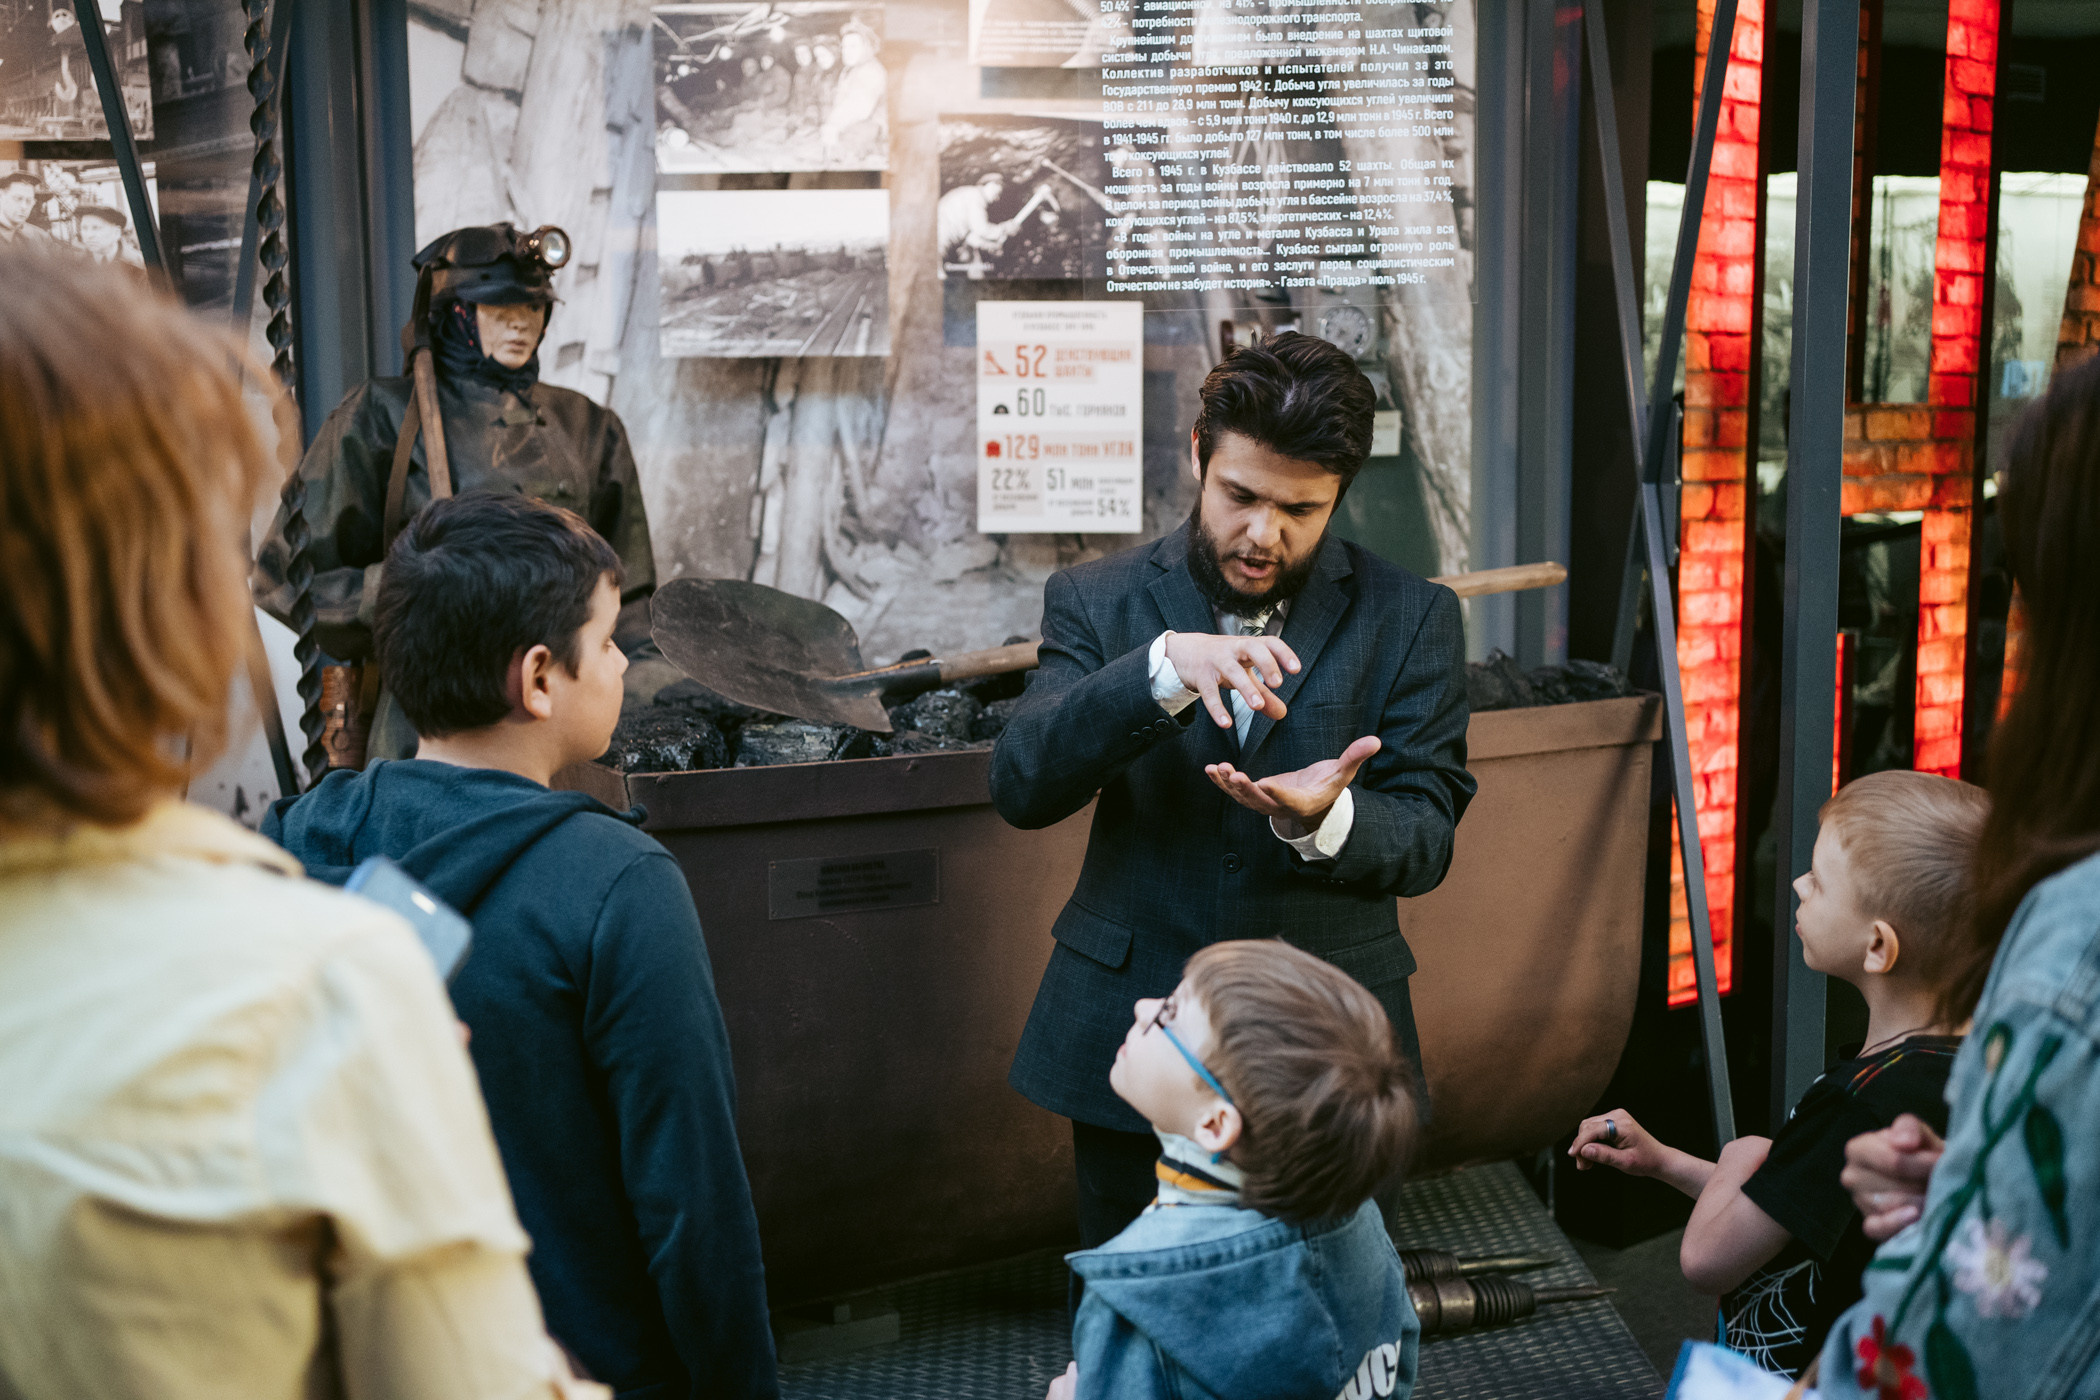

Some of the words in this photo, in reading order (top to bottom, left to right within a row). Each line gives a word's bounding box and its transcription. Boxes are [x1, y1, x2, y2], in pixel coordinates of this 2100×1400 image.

[1132, 15, 1196, 29] потребности
[1302, 13, 1363, 25] транспорта.
[1110, 32, 1175, 47] Крупнейшим
[1255, 30, 1282, 42] было
[1288, 31, 1343, 42] внедрение
[1348, 30, 1360, 39] на
[1366, 29, 1403, 39] шахтах
[1408, 25, 1453, 39] щитовой
[1102, 52, 1147, 63] системы
[1151, 49, 1191, 63] добычи
[1306, 47, 1365, 58] инженером
[1370, 43, 1389, 55] Н.А.
[1393, 43, 1453, 55] Чинакалом.
[1102, 67, 1163, 79] Коллектив
[1170, 65, 1258, 79] разработчиков
[1265, 66, 1271, 75] и
[1278, 60, 1354, 74] испытателей
[1361, 62, 1408, 74] получил
[1415, 61, 1428, 70] за
[1435, 61, 1453, 70] это
[1102, 84, 1192, 97] Государственную
[1196, 83, 1236, 95] премию
[1240, 80, 1261, 92] 1942
[1274, 79, 1315, 93] Добыча
[1318, 81, 1340, 92] угля
[1343, 79, 1409, 92] увеличилась
[1412, 78, 1424, 88] за
[1428, 78, 1453, 88] годы
[1103, 100, 1123, 112] ВОВ
[1156, 101, 1169, 112] до
[1172, 98, 1193, 111] 28,9
[1197, 100, 1216, 109] млн
[1220, 99, 1245, 109] тонн.
[1249, 96, 1289, 110] Добычу
[1293, 96, 1363, 109] коксующихся
[1366, 93, 1395, 107] углей
[1398, 94, 1453, 106] увеличили
[1206, 114, 1220, 127] 5,9
[1222, 116, 1242, 125] млн
[1244, 115, 1267, 125] тонн
[1269, 112, 1291, 124] 1940
[1302, 114, 1315, 125] до
[1317, 111, 1334, 124] 12,9
[1337, 113, 1356, 122] млн
[1359, 112, 1381, 122] тонн
[1392, 109, 1413, 121] 1945
[1424, 109, 1453, 120] Всего
[1112, 132, 1158, 145] 1941-1945
[1175, 132, 1202, 143] было
[1205, 131, 1243, 144] добыто
[1246, 130, 1260, 141] 127
[1264, 131, 1283, 141] млн
[1287, 131, 1312, 141] тонн,
[1324, 130, 1342, 139] том
[1345, 129, 1375, 139] числе
[1379, 126, 1409, 138] более
[1412, 125, 1430, 137] 500
[1434, 127, 1453, 136] млн
[1129, 150, 1198, 162] коксующихся
[1200, 146, 1231, 161] углей.
[1113, 166, 1142, 178] Всего
[1160, 165, 1182, 176] 1945
[1213, 163, 1261, 177] Кузбассе
[1267, 161, 1333, 175] действовало
[1339, 160, 1351, 172] 52
[1400, 158, 1436, 171] Общая
[1442, 160, 1454, 169] их
[1105, 184, 1157, 195] мощность
[1160, 183, 1172, 193] за
[1176, 183, 1201, 194] годы
[1205, 179, 1238, 191] войны
[1242, 181, 1290, 192] возросла
[1294, 179, 1345, 191] примерно
[1349, 179, 1361, 188] на
[1365, 176, 1369, 187] 7
[1374, 178, 1393, 187] млн
[1398, 177, 1420, 187] тонн
[1434, 176, 1453, 187] год.
[1114, 201, 1146, 212] целом
[1148, 200, 1160, 210] за
[1162, 199, 1199, 211] период
[1201, 196, 1233, 208] войны
[1235, 196, 1275, 209] добыча
[1277, 197, 1299, 209] угля
[1309, 193, 1357, 206] бассейне
[1360, 194, 1408, 206] возросла
[1410, 194, 1421, 203] на
[1106, 216, 1176, 228] коксующихся
[1177, 213, 1206, 227] углей
[1215, 215, 1226, 224] на
[1260, 213, 1341, 225] энергетических
[1350, 212, 1362, 221] на
[1132, 233, 1158, 244] годы
[1163, 229, 1196, 242] войны
[1201, 231, 1213, 241] на
[1218, 231, 1240, 242] угле
[1258, 229, 1300, 239] металле
[1305, 226, 1352, 240] Кузбасса
[1369, 224, 1399, 238] Урала
[1405, 225, 1431, 235] жила
[1437, 225, 1454, 234] вся
[1106, 248, 1163, 261] оборонная
[1277, 243, 1320, 257] Кузбасс
[1325, 244, 1364, 255] сыграл
[1370, 242, 1423, 254] огромную
[1429, 241, 1454, 253] роль
[1119, 262, 1195, 275] Отечественной
[1201, 261, 1233, 274] войне,
[1240, 263, 1246, 272] и
[1251, 263, 1268, 272] его
[1274, 261, 1314, 273] заслуги
[1320, 260, 1352, 272] перед
[1357, 258, 1454, 270] социалистическим
[1107, 280, 1166, 292] Отечеством
[1168, 281, 1180, 290] не
[1182, 278, 1222, 292] забудет
[1281, 276, 1315, 288] Газета
[1317, 275, 1367, 289] «Правда»
[1369, 276, 1395, 285] июль
[1397, 273, 1418, 285] 1945
[1016, 345, 1047, 378] 52
[1017, 388, 1045, 416] 60
[1005, 434, 1039, 460] 129
[992, 468, 1030, 490] 22%
[1047, 467, 1065, 491] 51
